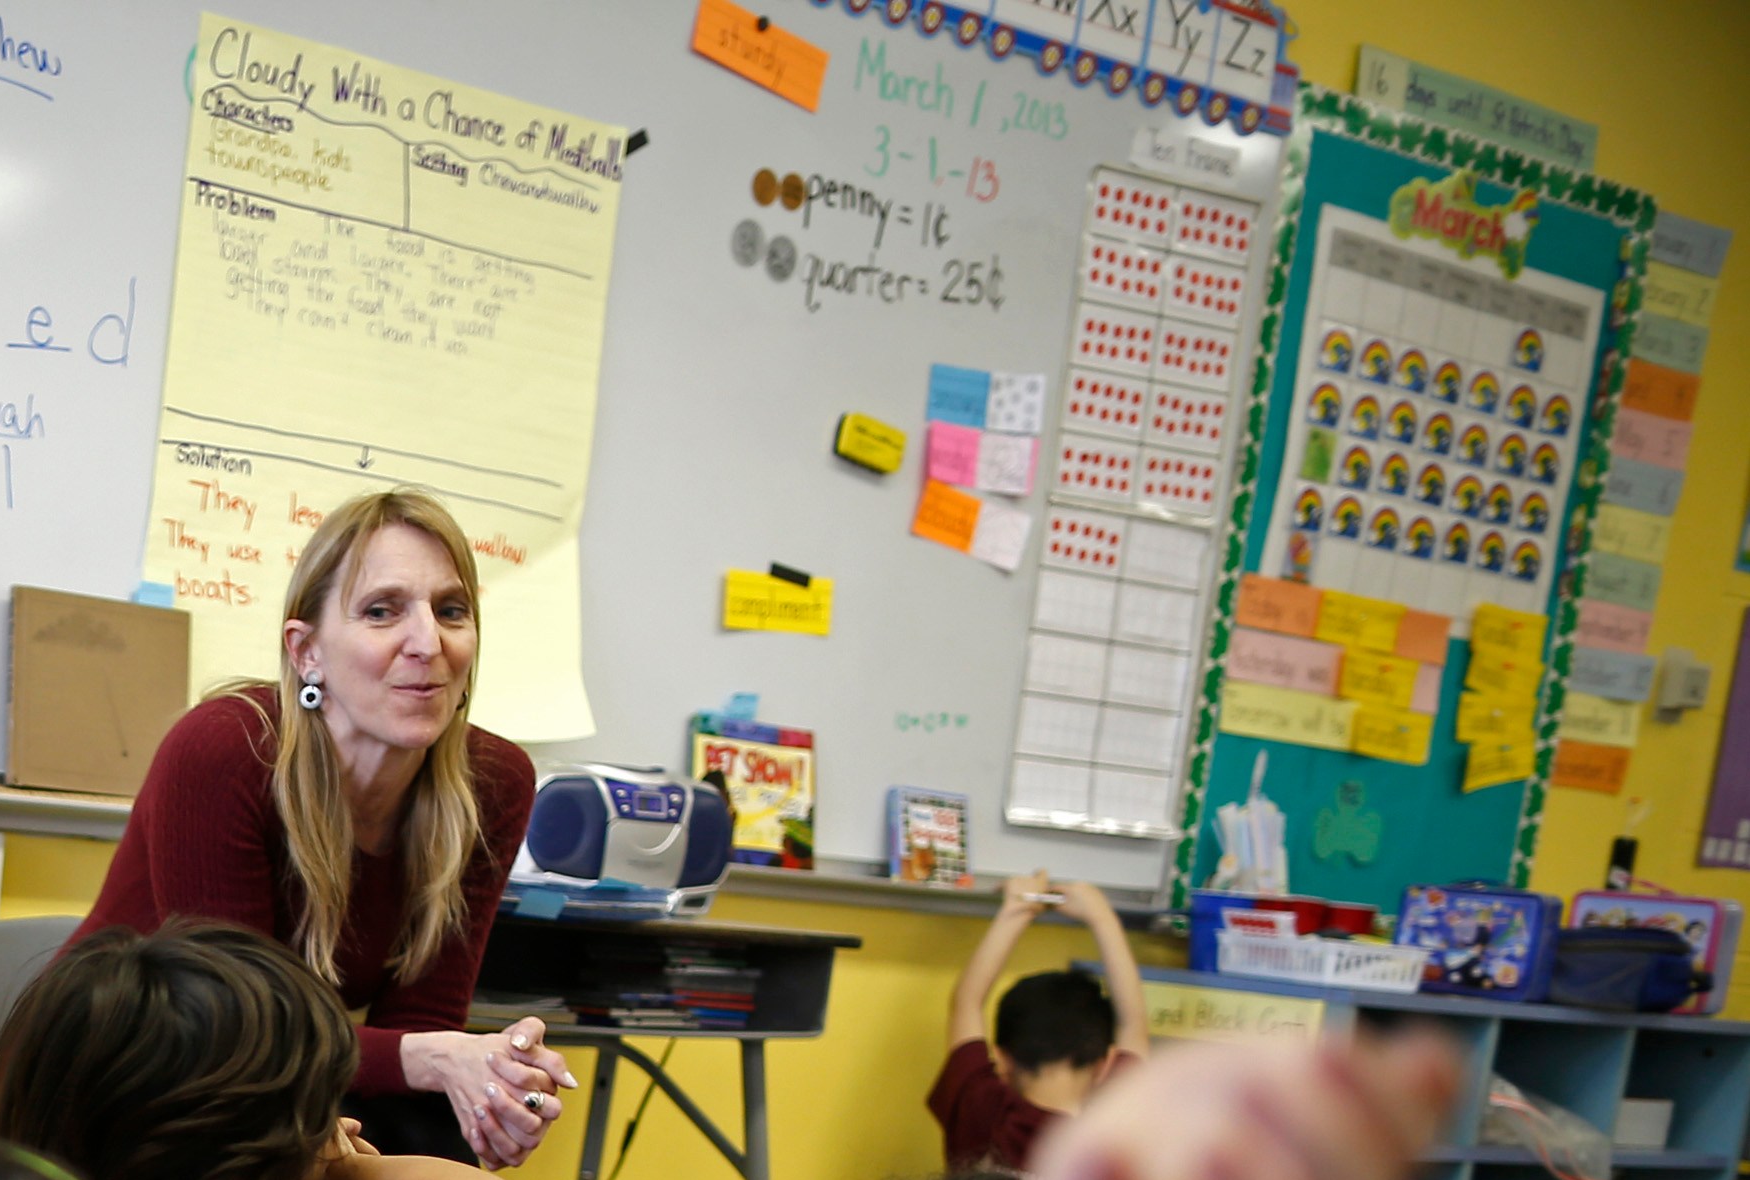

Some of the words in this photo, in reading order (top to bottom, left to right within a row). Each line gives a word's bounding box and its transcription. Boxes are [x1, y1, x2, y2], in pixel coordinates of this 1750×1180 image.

[210, 26, 315, 113] Cloudy
[331, 60, 387, 118] With
[396, 96, 416, 122] a
[423, 89, 507, 148] Chance
[514, 118, 544, 153] of
[853, 36, 956, 120] March
[194, 182, 276, 223] Problem
[1410, 187, 1508, 253] March
[188, 479, 257, 531] They
[162, 516, 210, 563] They
